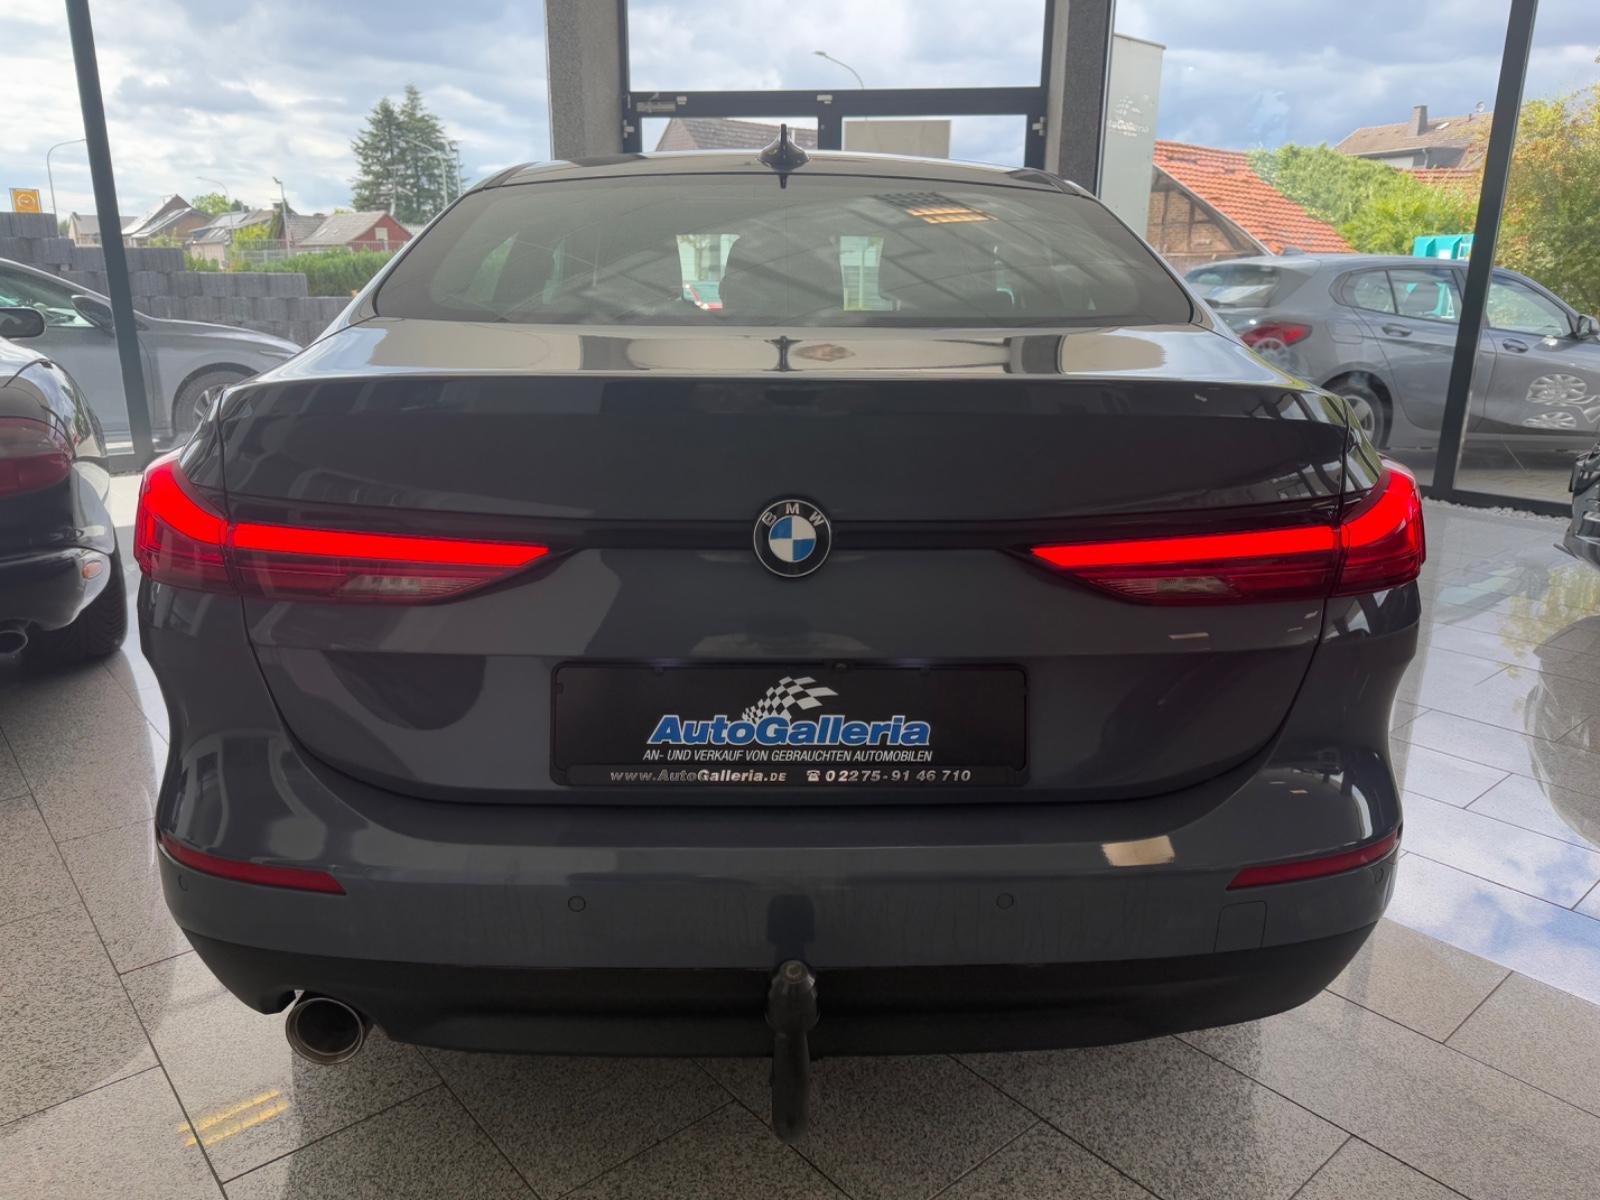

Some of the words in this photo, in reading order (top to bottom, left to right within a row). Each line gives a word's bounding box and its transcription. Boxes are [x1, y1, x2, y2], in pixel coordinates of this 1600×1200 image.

[762, 502, 824, 527] BMW
[646, 714, 932, 746] AutoGalleria
[642, 749, 664, 761] AN-
[667, 749, 692, 761] UND
[694, 749, 744, 761] VERKAUF
[745, 749, 769, 761] VON
[771, 749, 852, 762] GEBRAUCHTEN
[853, 750, 933, 762] AUTOMOBILEN
[916, 769, 937, 782] 46
[942, 769, 971, 782] 710
